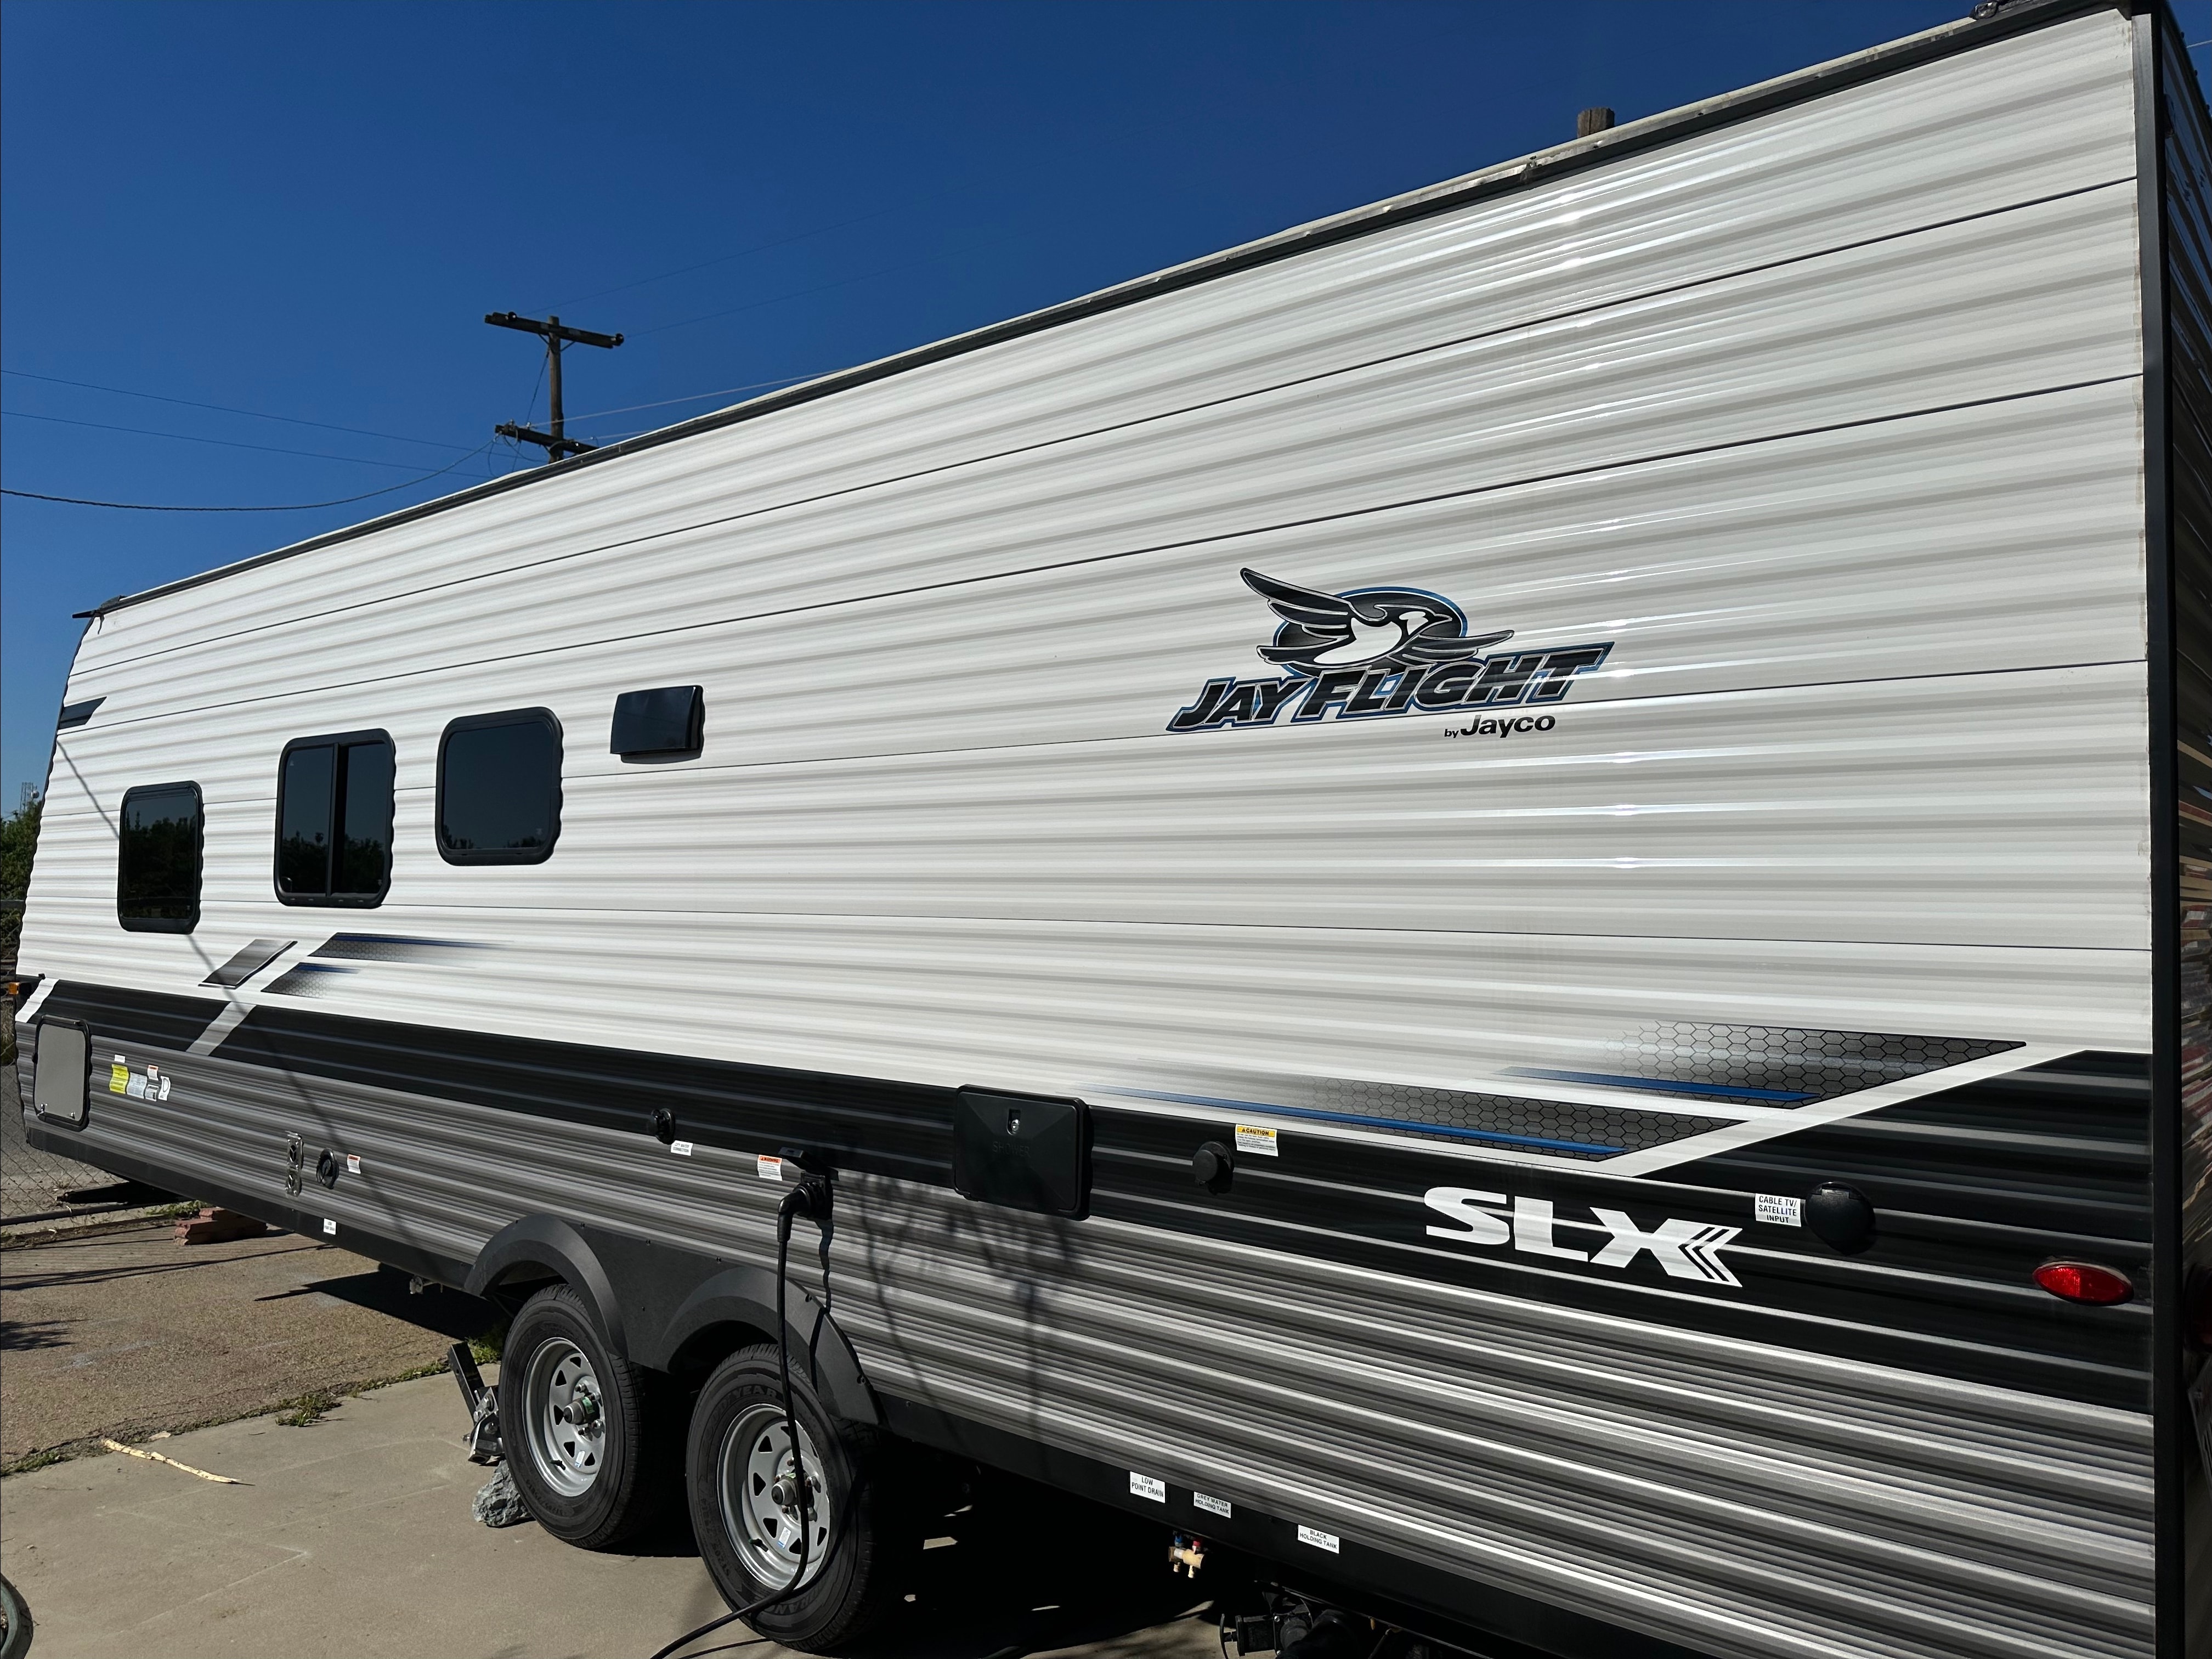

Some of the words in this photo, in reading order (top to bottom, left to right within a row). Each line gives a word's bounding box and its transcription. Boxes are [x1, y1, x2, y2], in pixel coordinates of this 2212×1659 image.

[1167, 675, 1316, 732] JAY
[1292, 641, 1614, 722] FLIGHT
[1444, 727, 1459, 739] by
[1460, 714, 1556, 739] Jayco
[992, 1141, 1032, 1158] SHOWER
[1759, 1195, 1783, 1205] CABLE
[1785, 1198, 1797, 1207] TV/
[1758, 1204, 1797, 1216] SATELLITE
[1767, 1214, 1789, 1223] INPUT
[1423, 1186, 1743, 1288] SLX
[1141, 1476, 1153, 1486] LOW
[1132, 1482, 1146, 1492] POINT
[1148, 1486, 1164, 1497] DRAIN
[1195, 1498, 1216, 1509] HOLDING
[1217, 1505, 1229, 1514] TANK
[1197, 1493, 1210, 1503] GREY
[1210, 1497, 1228, 1508] WATER
[1299, 1532, 1322, 1544] HOLDING
[1323, 1540, 1337, 1549] TANK
[1310, 1530, 1327, 1539] BLACK
